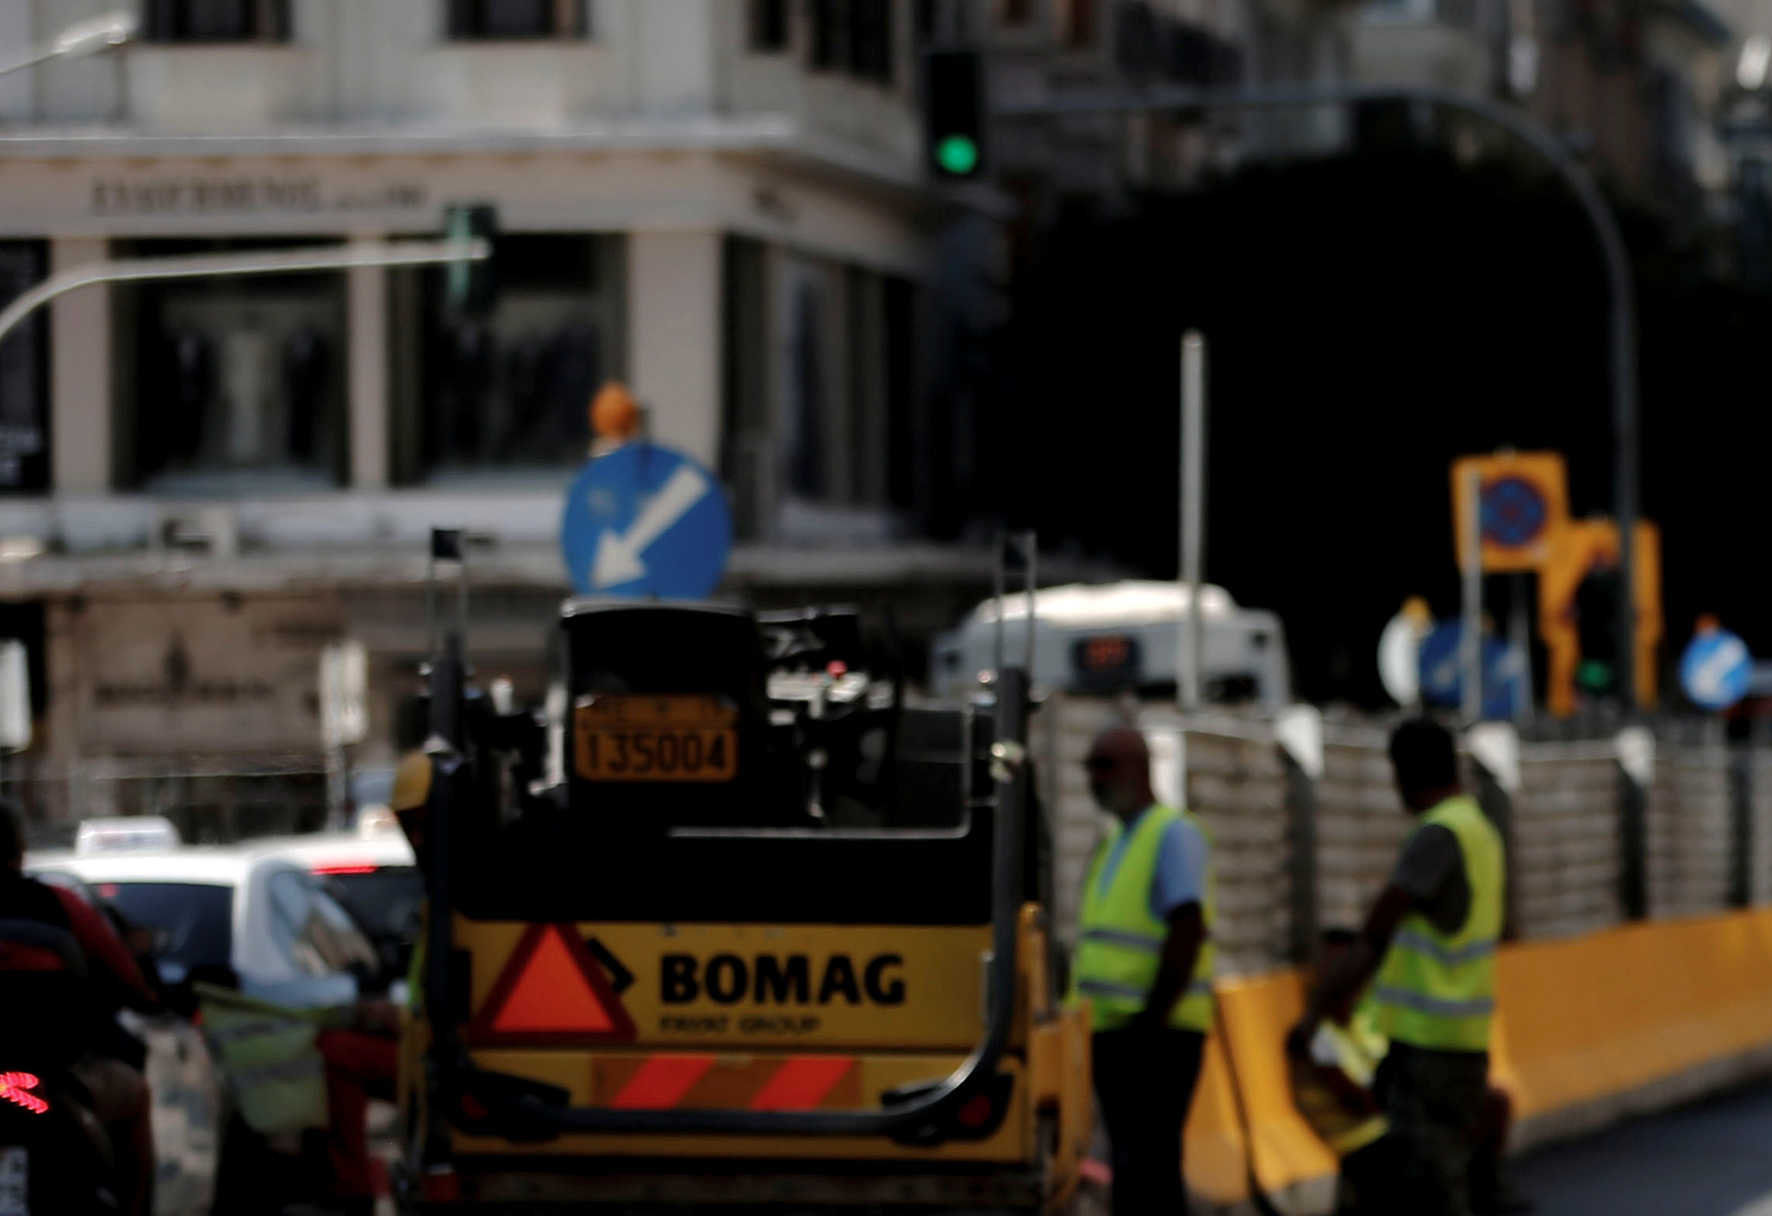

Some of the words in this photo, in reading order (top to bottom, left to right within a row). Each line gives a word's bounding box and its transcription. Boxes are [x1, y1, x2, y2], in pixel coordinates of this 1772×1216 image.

[587, 732, 726, 772] 135004
[661, 955, 904, 1004] BOMAG
[738, 1015, 821, 1034] GROUP
